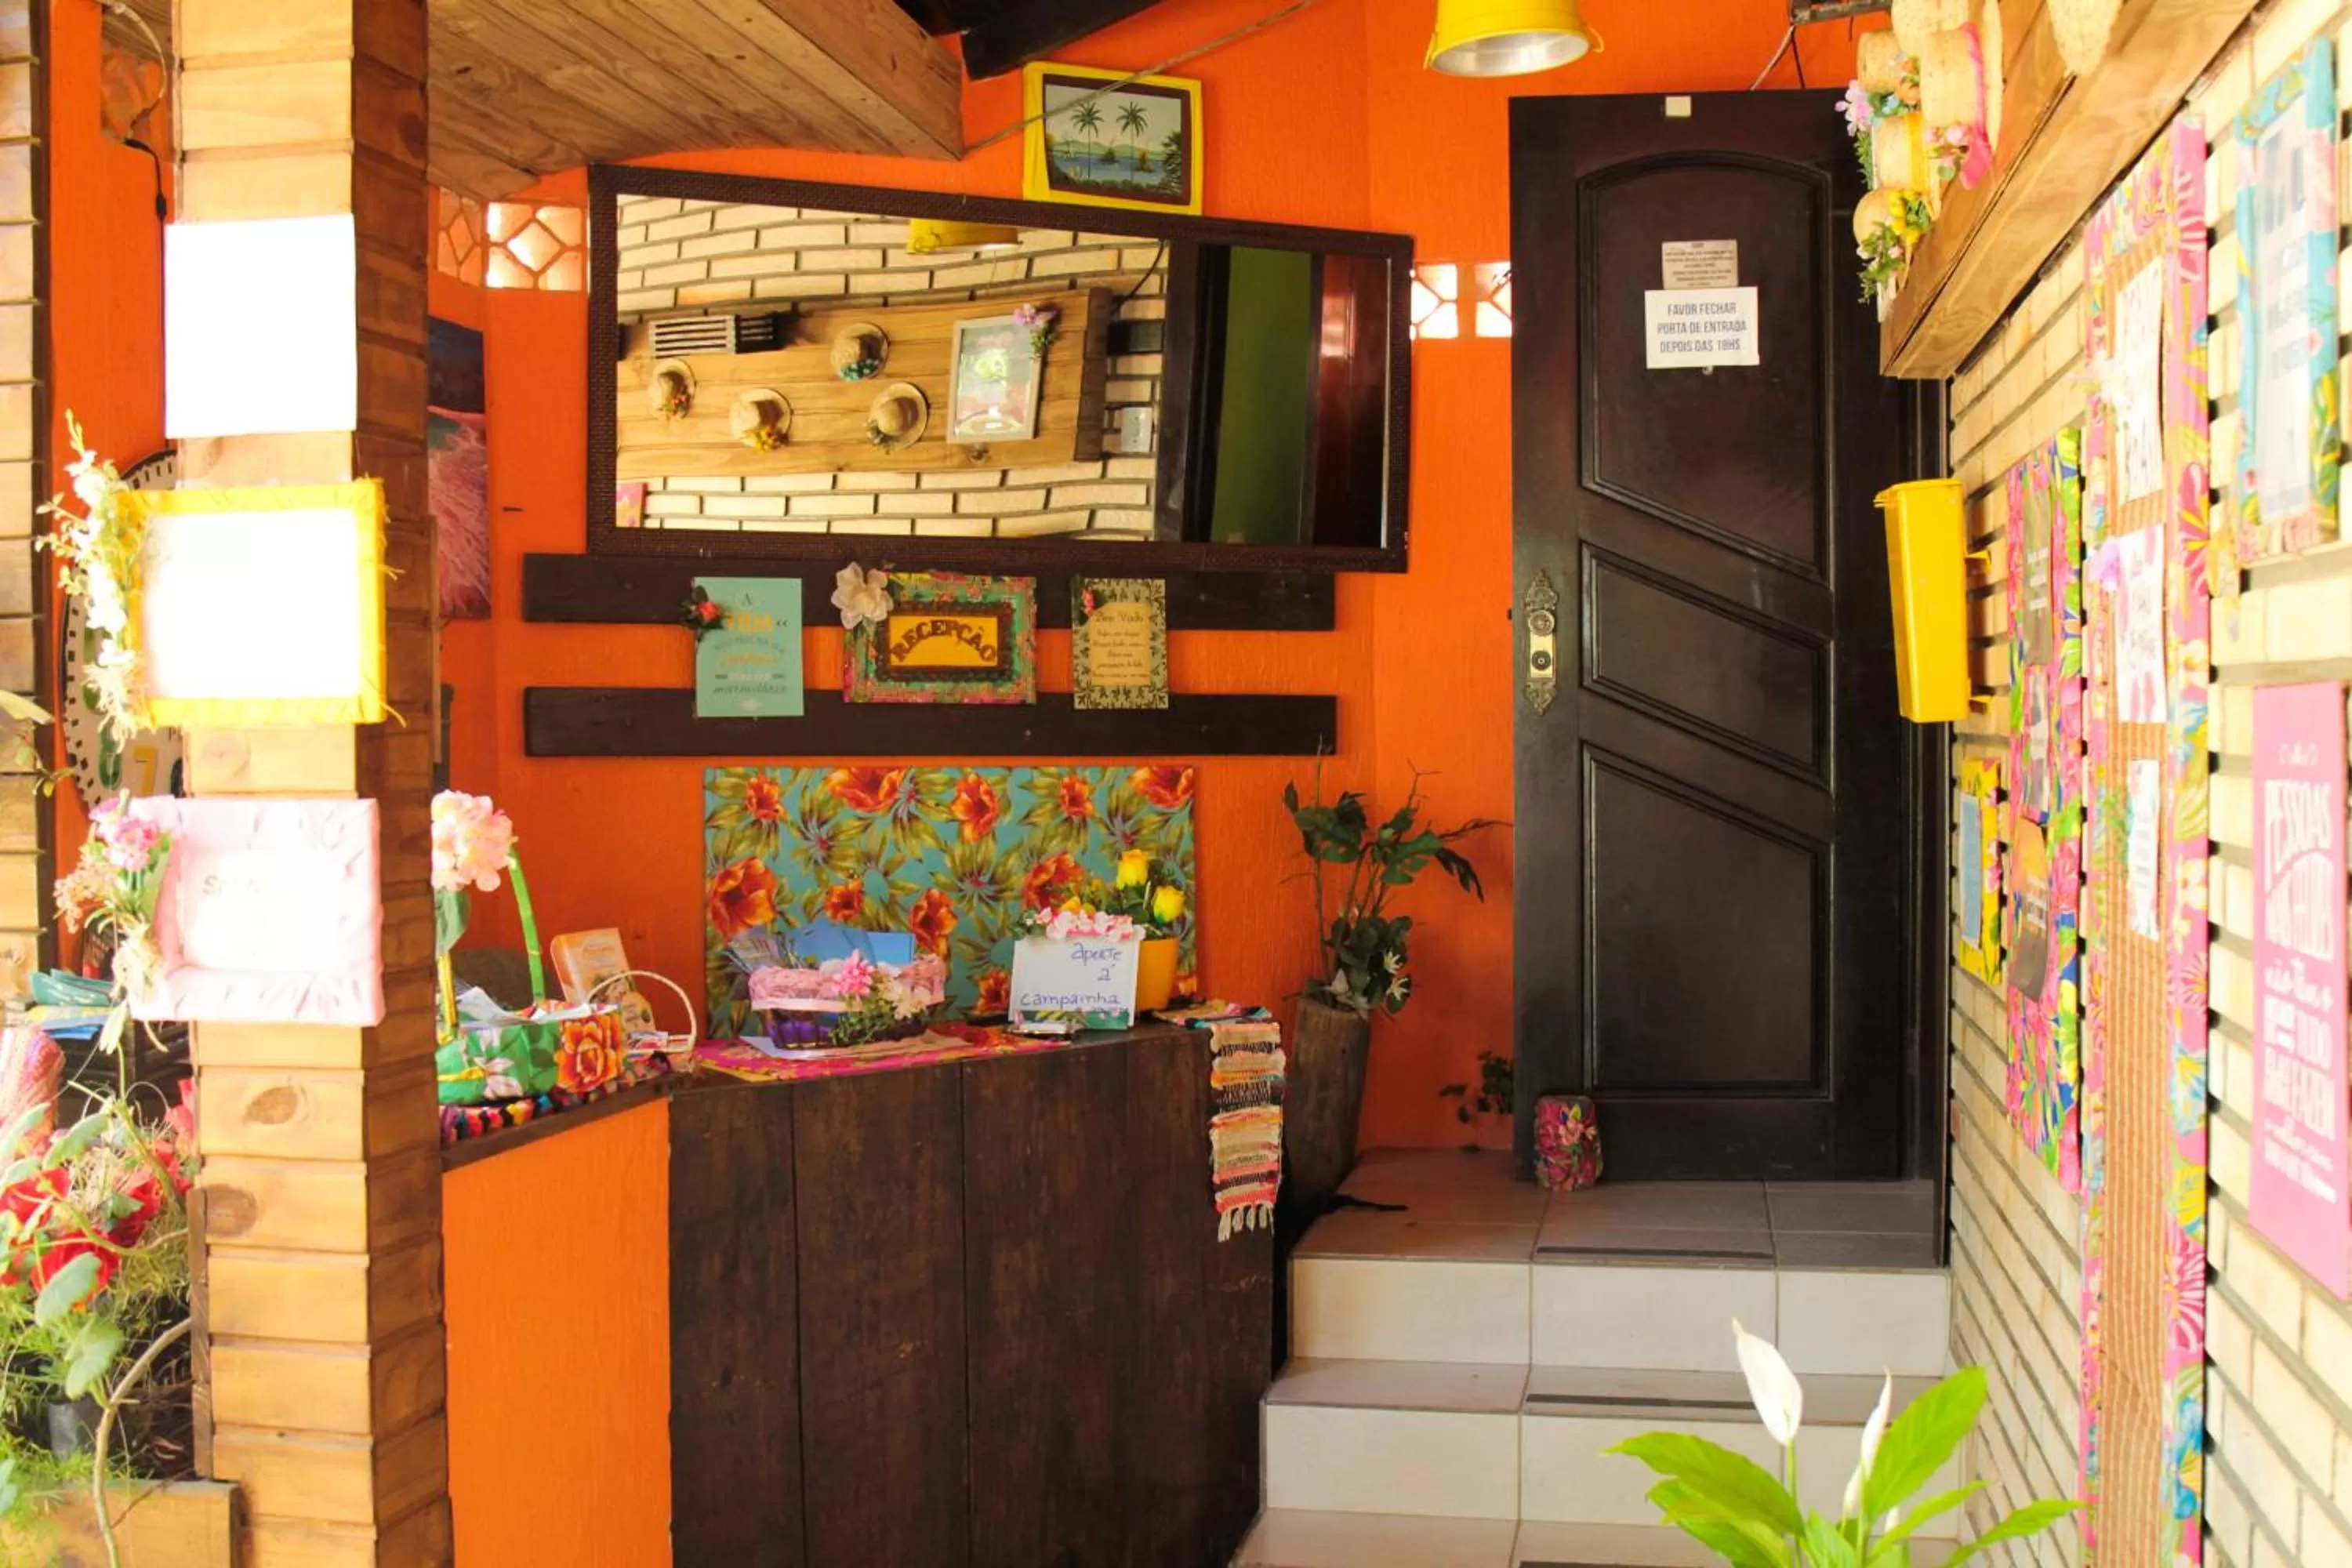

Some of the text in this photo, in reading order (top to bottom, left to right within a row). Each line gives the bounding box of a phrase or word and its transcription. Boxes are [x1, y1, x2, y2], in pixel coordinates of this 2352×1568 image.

[1667, 301, 1737, 316] FAVOR FECHAR
[1657, 319, 1748, 335] PORTA DE ENTRADA
[1659, 339, 1693, 354] DEPOIS
[1694, 339, 1713, 352] DAS
